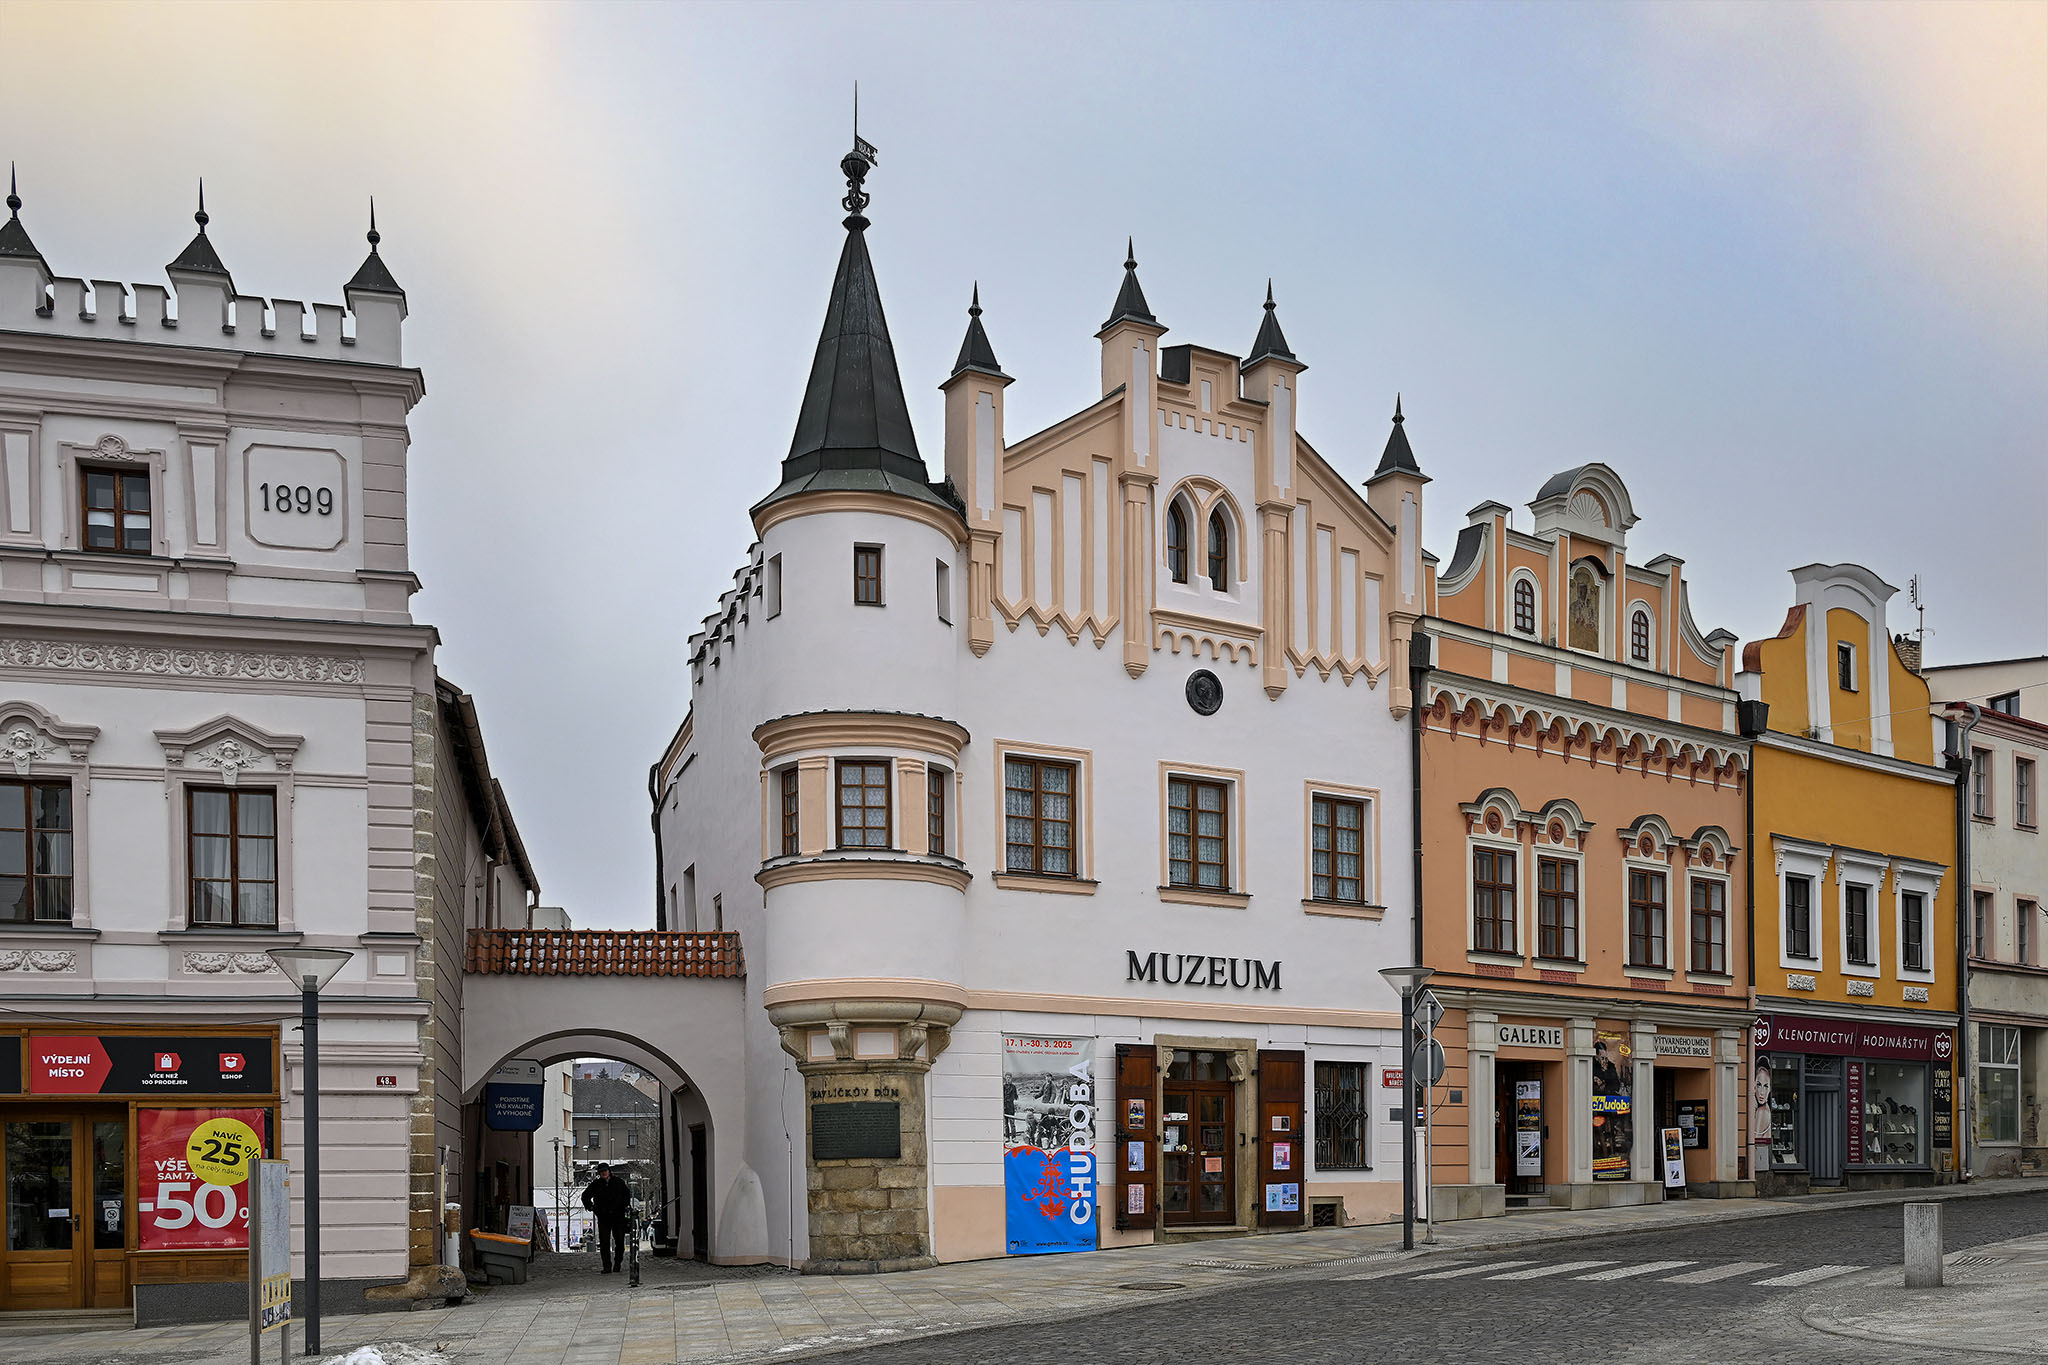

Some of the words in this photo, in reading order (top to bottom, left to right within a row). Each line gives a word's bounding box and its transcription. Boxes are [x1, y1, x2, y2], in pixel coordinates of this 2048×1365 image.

[260, 483, 333, 516] 1899
[1126, 949, 1283, 990] MUZEUM
[1500, 1027, 1561, 1044] GALERIE
[1777, 1028, 1854, 1045] KLENOTNICTVÍ
[1862, 1035, 1928, 1050] HODINÁŘSTVÍ
[1005, 1038, 1018, 1047] 17.
[1053, 1040, 1073, 1049] 2025
[1936, 1040, 1950, 1052] ego
[42, 1053, 91, 1065] VÝDEJNÍ
[48, 1067, 85, 1078] MÍSTO
[212, 1130, 243, 1142] NAVÍC
[1069, 1059, 1092, 1225] CHUDOBA
[154, 1157, 187, 1171] VŠE
[157, 1172, 182, 1180] SAM
